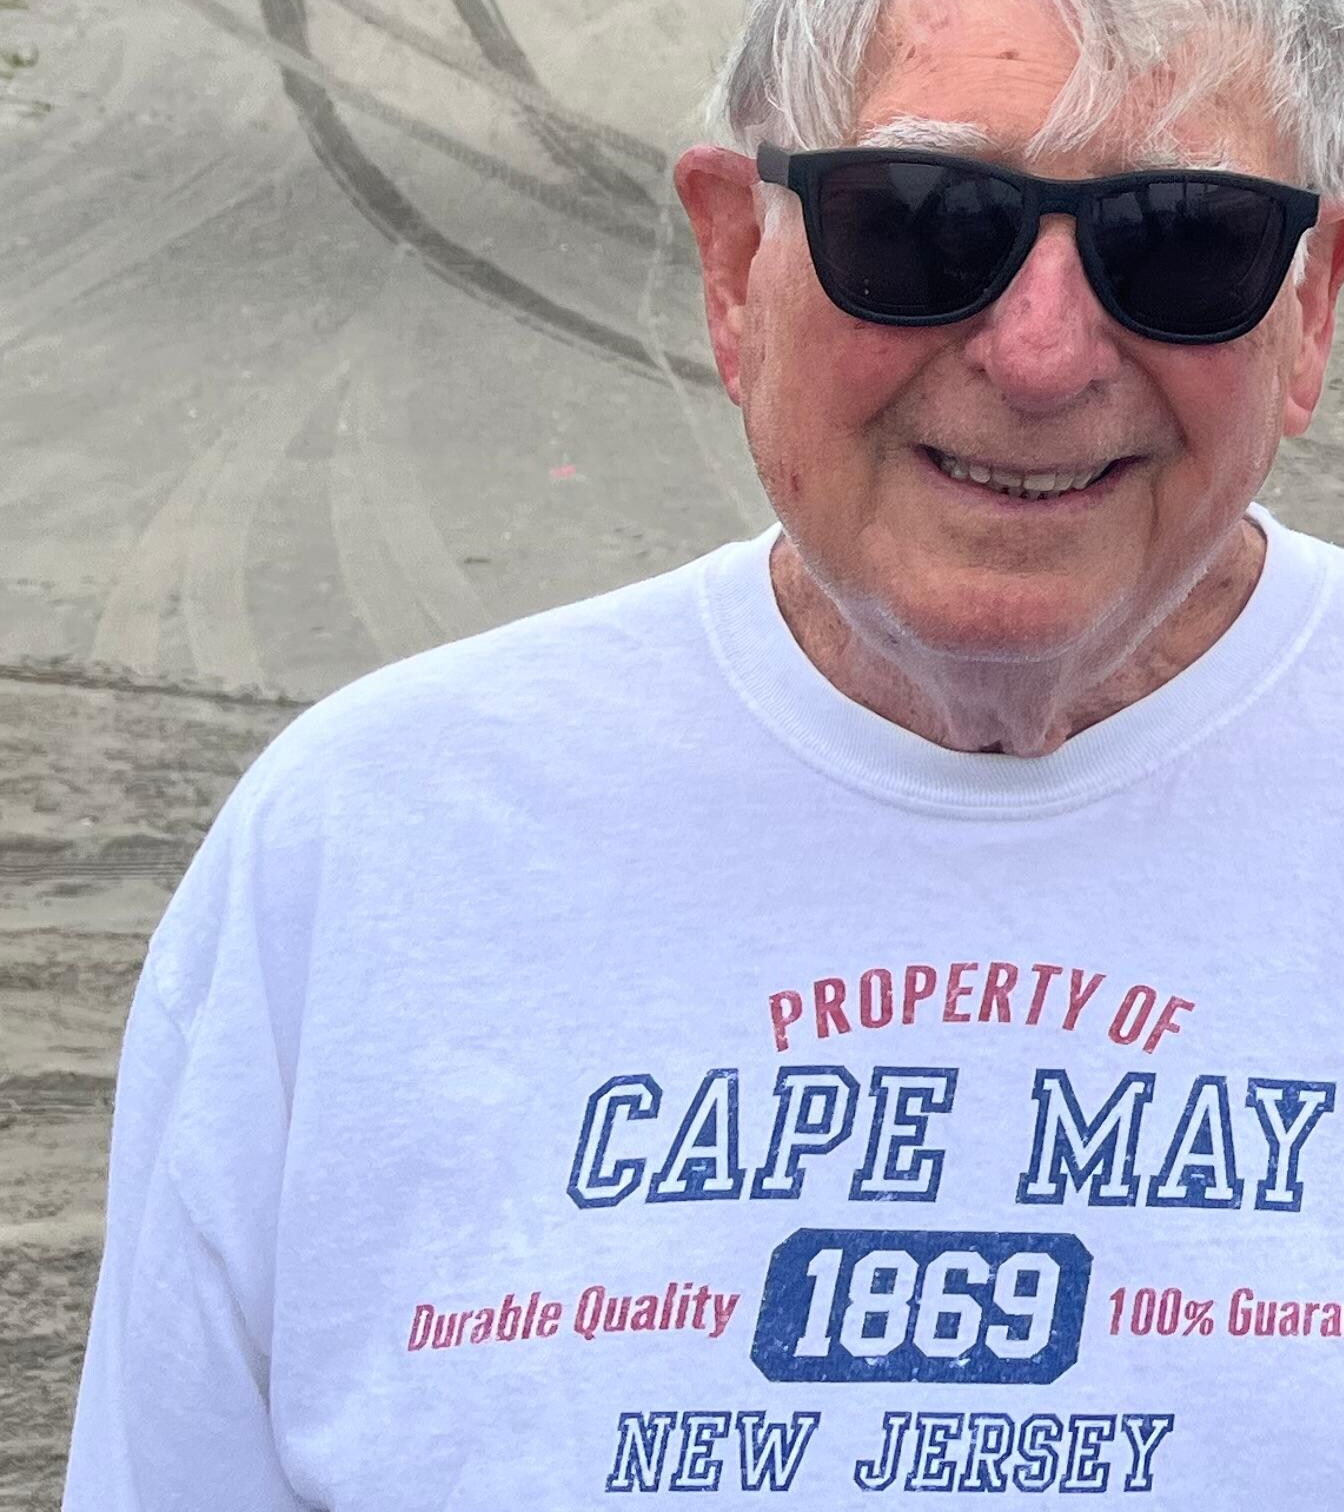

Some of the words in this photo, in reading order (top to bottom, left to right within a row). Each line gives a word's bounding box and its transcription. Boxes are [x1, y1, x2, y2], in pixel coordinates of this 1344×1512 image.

[768, 961, 1108, 1053] PROPERTY
[1107, 984, 1196, 1055] OF
[566, 1064, 960, 1211] CAPE
[1015, 1068, 1336, 1212] MAY
[407, 1291, 562, 1352] Durable
[573, 1281, 741, 1340] Quality
[793, 1247, 1061, 1360] 1869
[1109, 1286, 1215, 1337] 100%
[604, 1410, 821, 1494] NEW
[853, 1410, 1175, 1494] JERSEY
